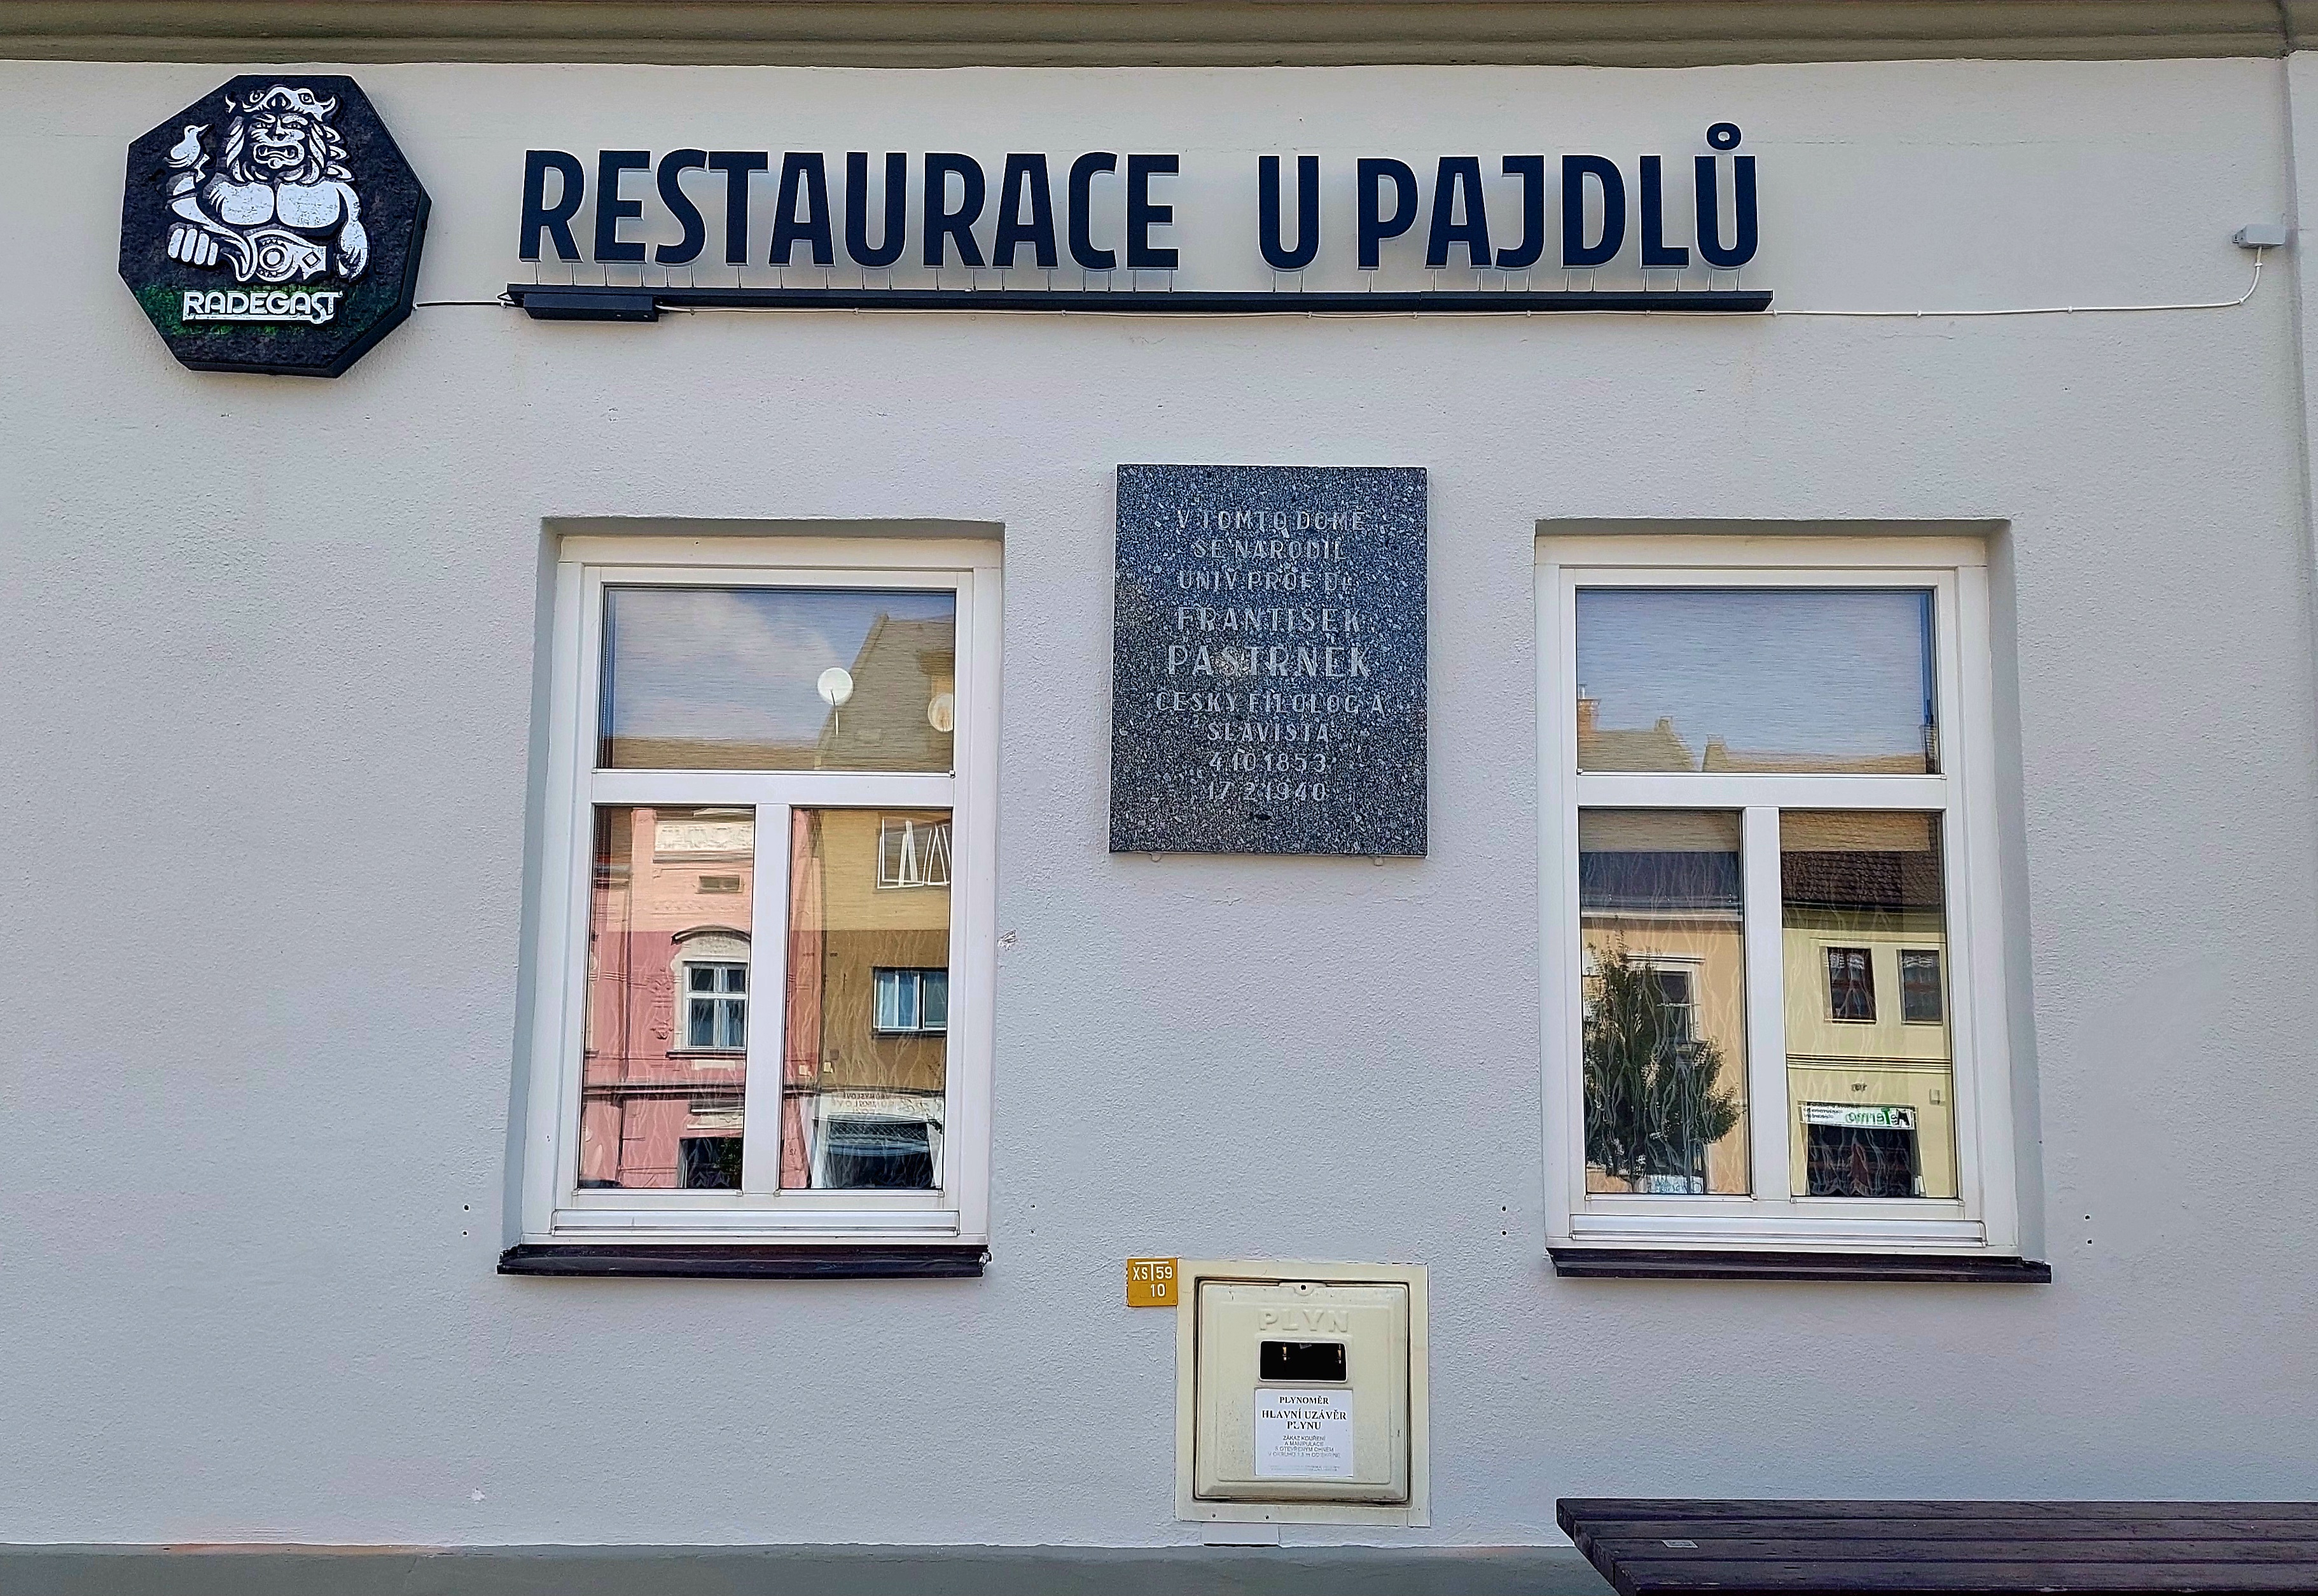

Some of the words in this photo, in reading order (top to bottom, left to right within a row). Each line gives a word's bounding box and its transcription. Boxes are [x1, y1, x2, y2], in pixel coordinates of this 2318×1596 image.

[518, 148, 1179, 271] RESTAURACE
[1257, 155, 1321, 272] U
[1356, 120, 1760, 272] PAJDLŮ
[183, 290, 343, 324] RADEGAST
[1177, 510, 1190, 529] V
[1202, 510, 1287, 531] TOMTO
[1193, 540, 1225, 559] SE
[1235, 540, 1347, 560] NARODIL
[1167, 644, 1370, 677] PASTRNEK
[1207, 723, 1329, 742] SLAVISTA
[1150, 1283, 1165, 1297] 10
[1259, 1308, 1349, 1333] PLYN
[1279, 1395, 1329, 1405] PLYNOMĚR
[1262, 1408, 1301, 1419] HLAVNÍ
[1305, 1409, 1347, 1420] UZÁVĚR
[1287, 1420, 1321, 1430] PLYNU
